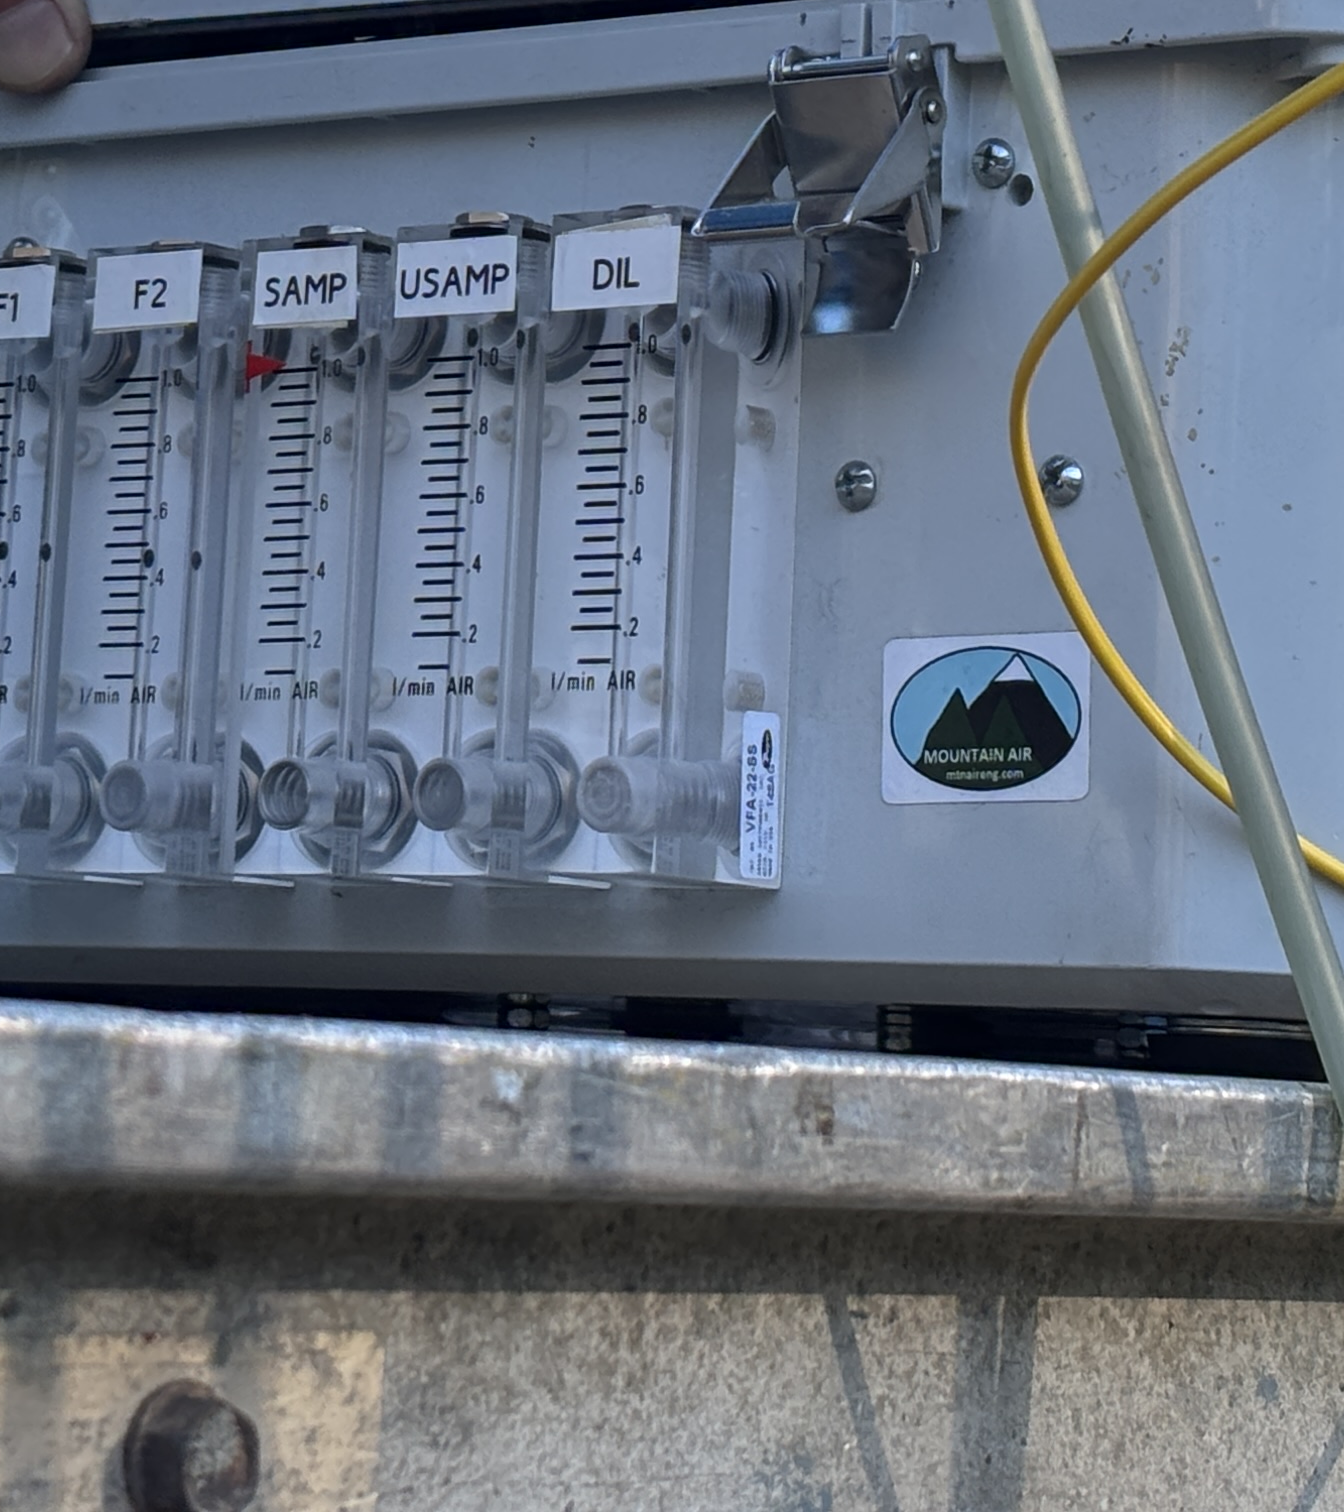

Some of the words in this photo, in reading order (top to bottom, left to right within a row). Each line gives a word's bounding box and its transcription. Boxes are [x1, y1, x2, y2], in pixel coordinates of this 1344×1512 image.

[400, 263, 510, 300] USAMP
[591, 256, 640, 290] DIL
[133, 278, 168, 309] F2
[264, 272, 347, 307] SAMP
[477, 348, 499, 367] 1.0
[161, 368, 182, 388] 1.0
[320, 358, 343, 379] 1.0
[15, 374, 37, 393] 1.0
[473, 415, 489, 436] .8
[632, 405, 648, 426] .8
[157, 434, 173, 454] .8
[317, 426, 332, 445] .8
[12, 439, 26, 458] .8
[469, 485, 486, 506] .6
[627, 475, 645, 496] .6
[152, 501, 168, 521] .6
[312, 493, 329, 513] .6
[6, 504, 22, 524] .6
[465, 554, 482, 575] .4
[625, 545, 643, 567] .4
[2, 569, 18, 589] .4
[149, 568, 165, 588] .4
[309, 561, 326, 582] .4
[460, 624, 478, 645] .2
[622, 616, 639, 638] .2
[145, 635, 161, 655] .2
[306, 629, 322, 650] .2
[446, 675, 474, 696] AIR
[606, 669, 636, 690] AIR
[130, 685, 156, 704] AIR
[291, 681, 319, 700] AIR
[924, 748, 1004, 764] MOUNTAIN
[1007, 747, 1032, 762] AIR
